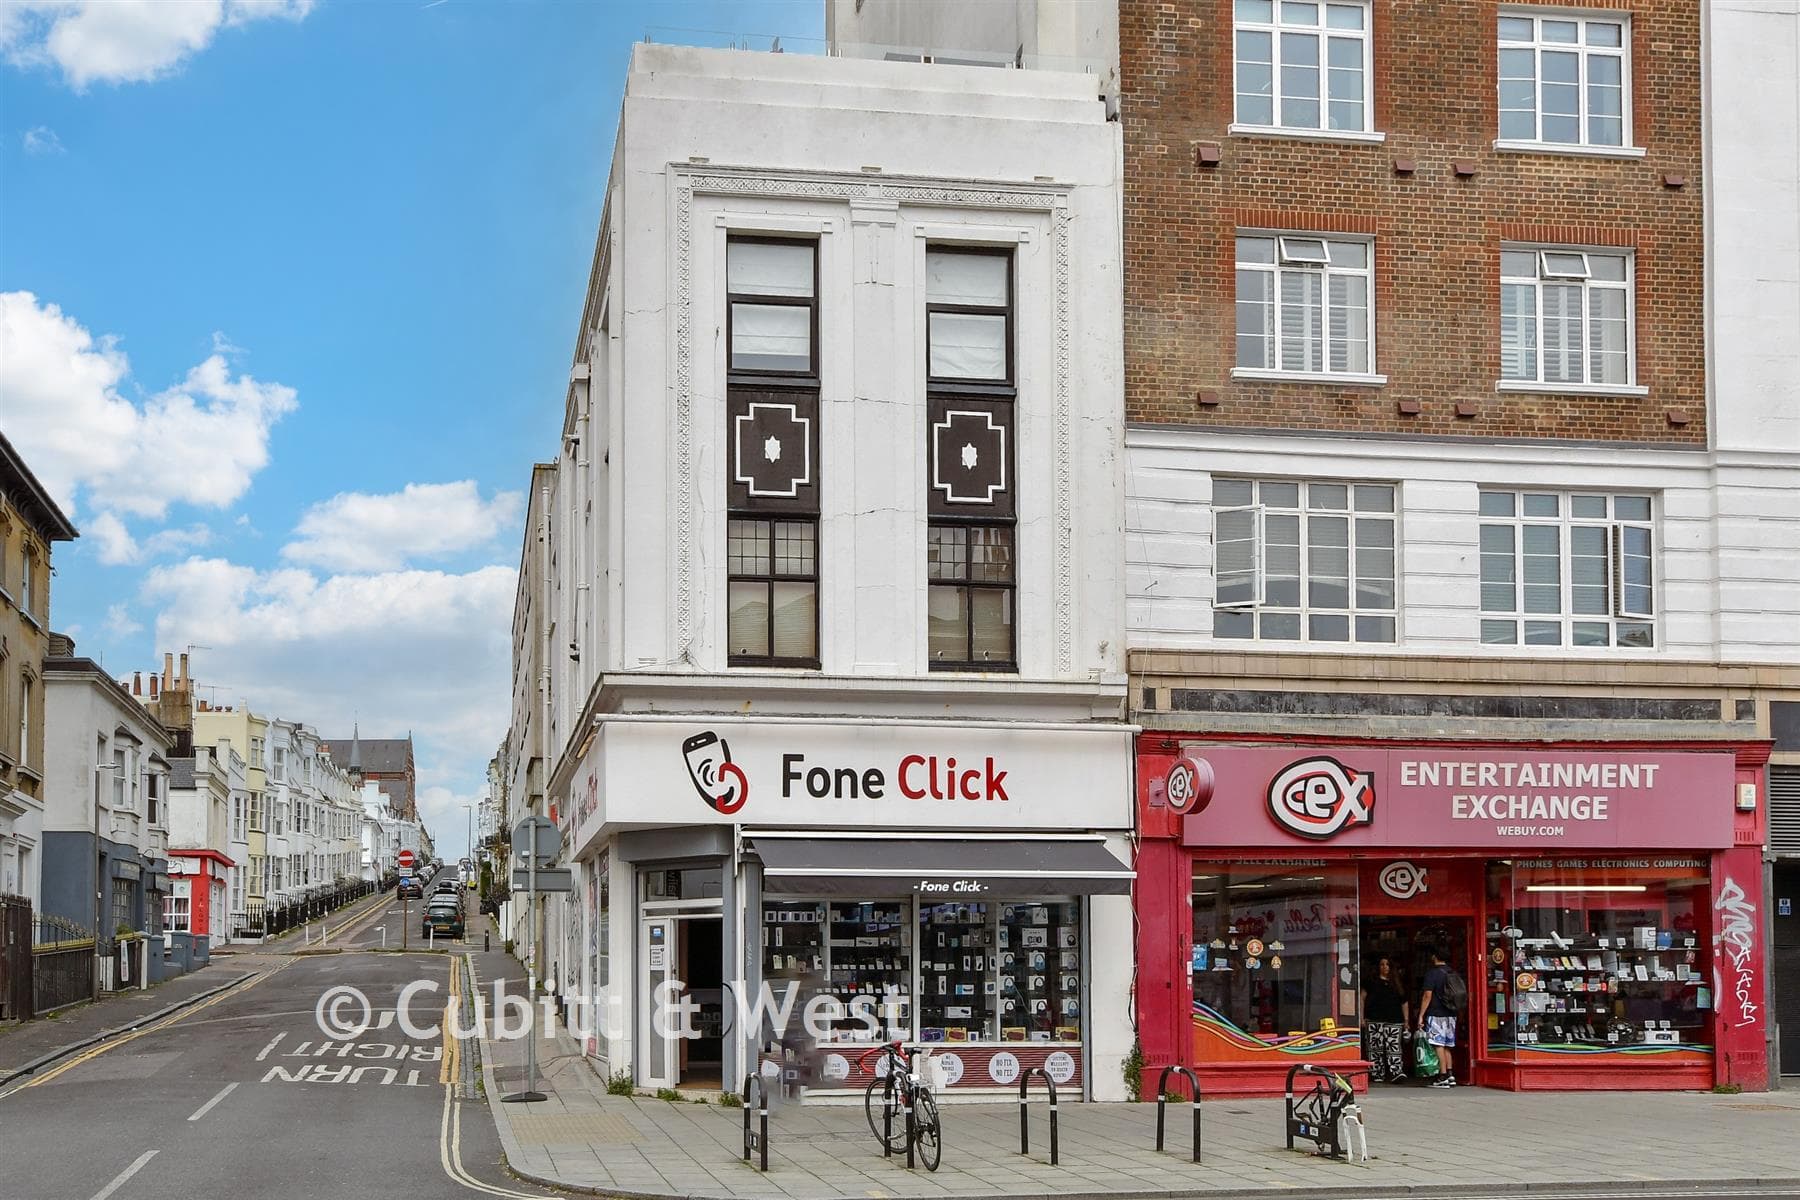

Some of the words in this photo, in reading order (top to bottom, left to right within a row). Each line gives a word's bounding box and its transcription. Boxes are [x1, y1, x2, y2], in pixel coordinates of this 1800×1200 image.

[782, 753, 885, 800] Fone
[898, 754, 1009, 802] Click
[1400, 761, 1660, 788] ENTERTAINMENT
[1451, 794, 1609, 820] EXCHANGE
[1496, 826, 1564, 836] WEBUY.COM
[1516, 860, 1553, 868] PHONES
[1556, 860, 1588, 868] GAMES
[1592, 859, 1650, 868] ELECTRONICS
[1653, 860, 1707, 868] COMPUTING
[920, 881, 950, 892] Fone
[953, 881, 982, 892] Click
[280, 1041, 444, 1062] RIGHT
[260, 1064, 431, 1087] TURN
